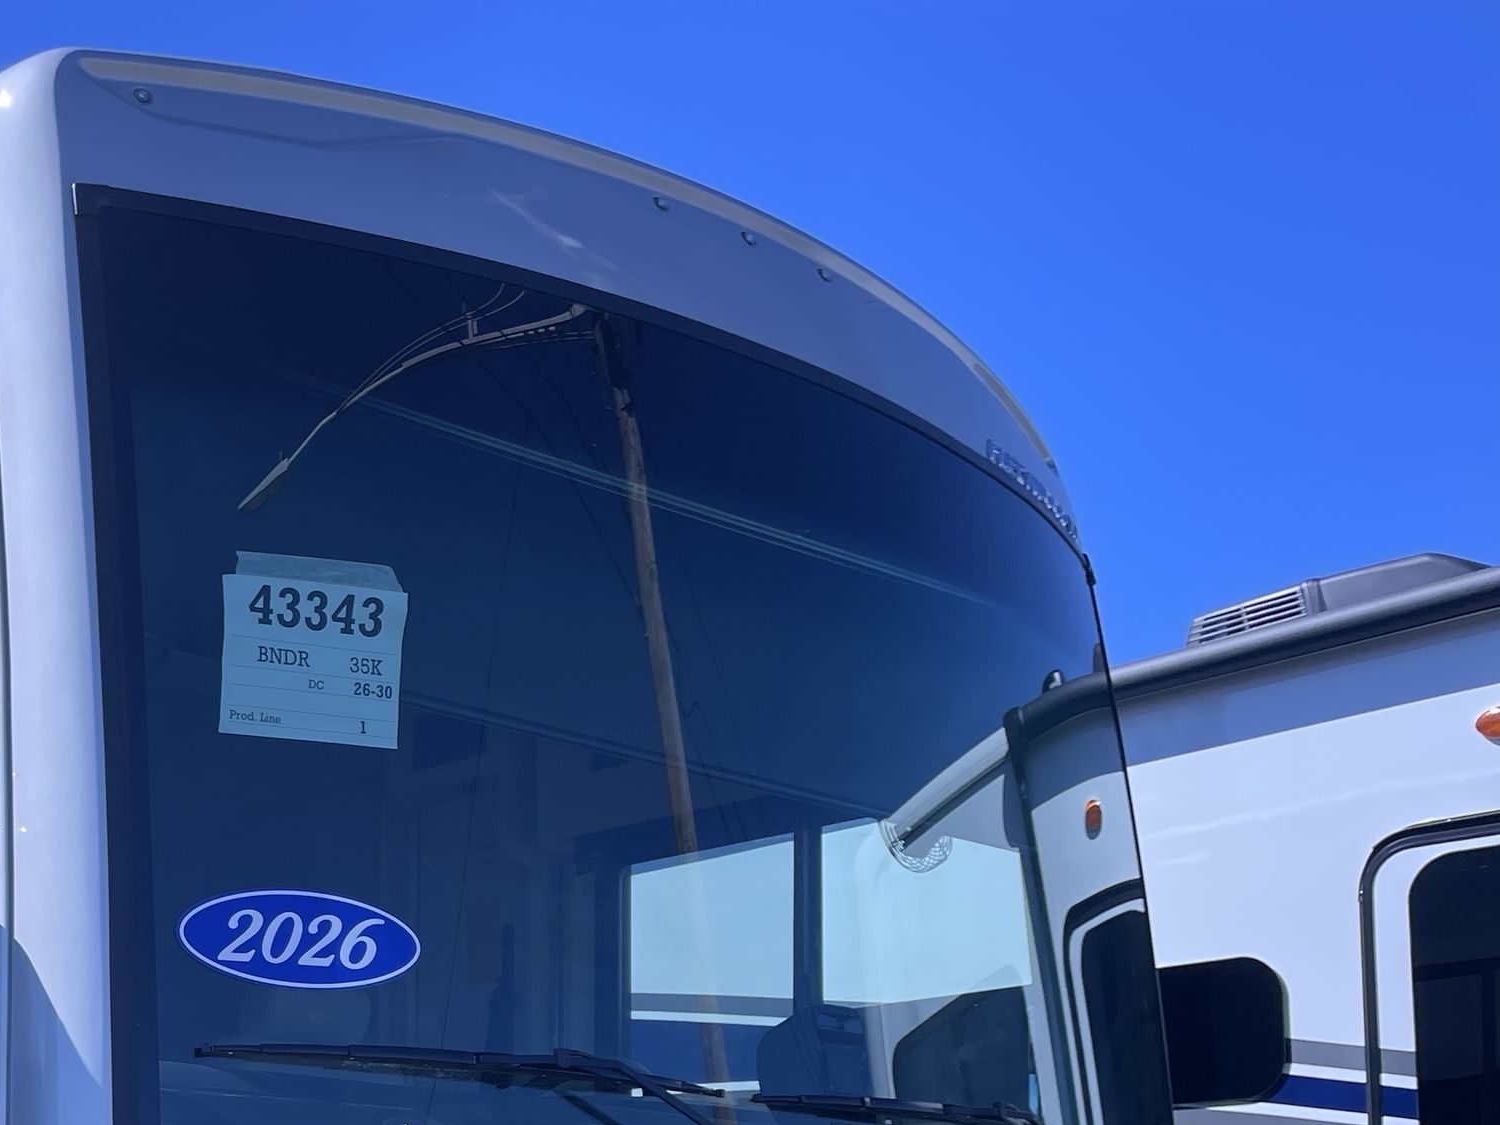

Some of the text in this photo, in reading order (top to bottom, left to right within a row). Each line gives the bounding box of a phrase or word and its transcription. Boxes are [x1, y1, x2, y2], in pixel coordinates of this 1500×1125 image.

[249, 584, 385, 638] 43343
[257, 645, 382, 677] BNDR 35K
[308, 679, 393, 700] DC 26-30
[229, 709, 282, 725] Prod. Line
[360, 721, 367, 734] 1
[217, 908, 385, 970] 2026
